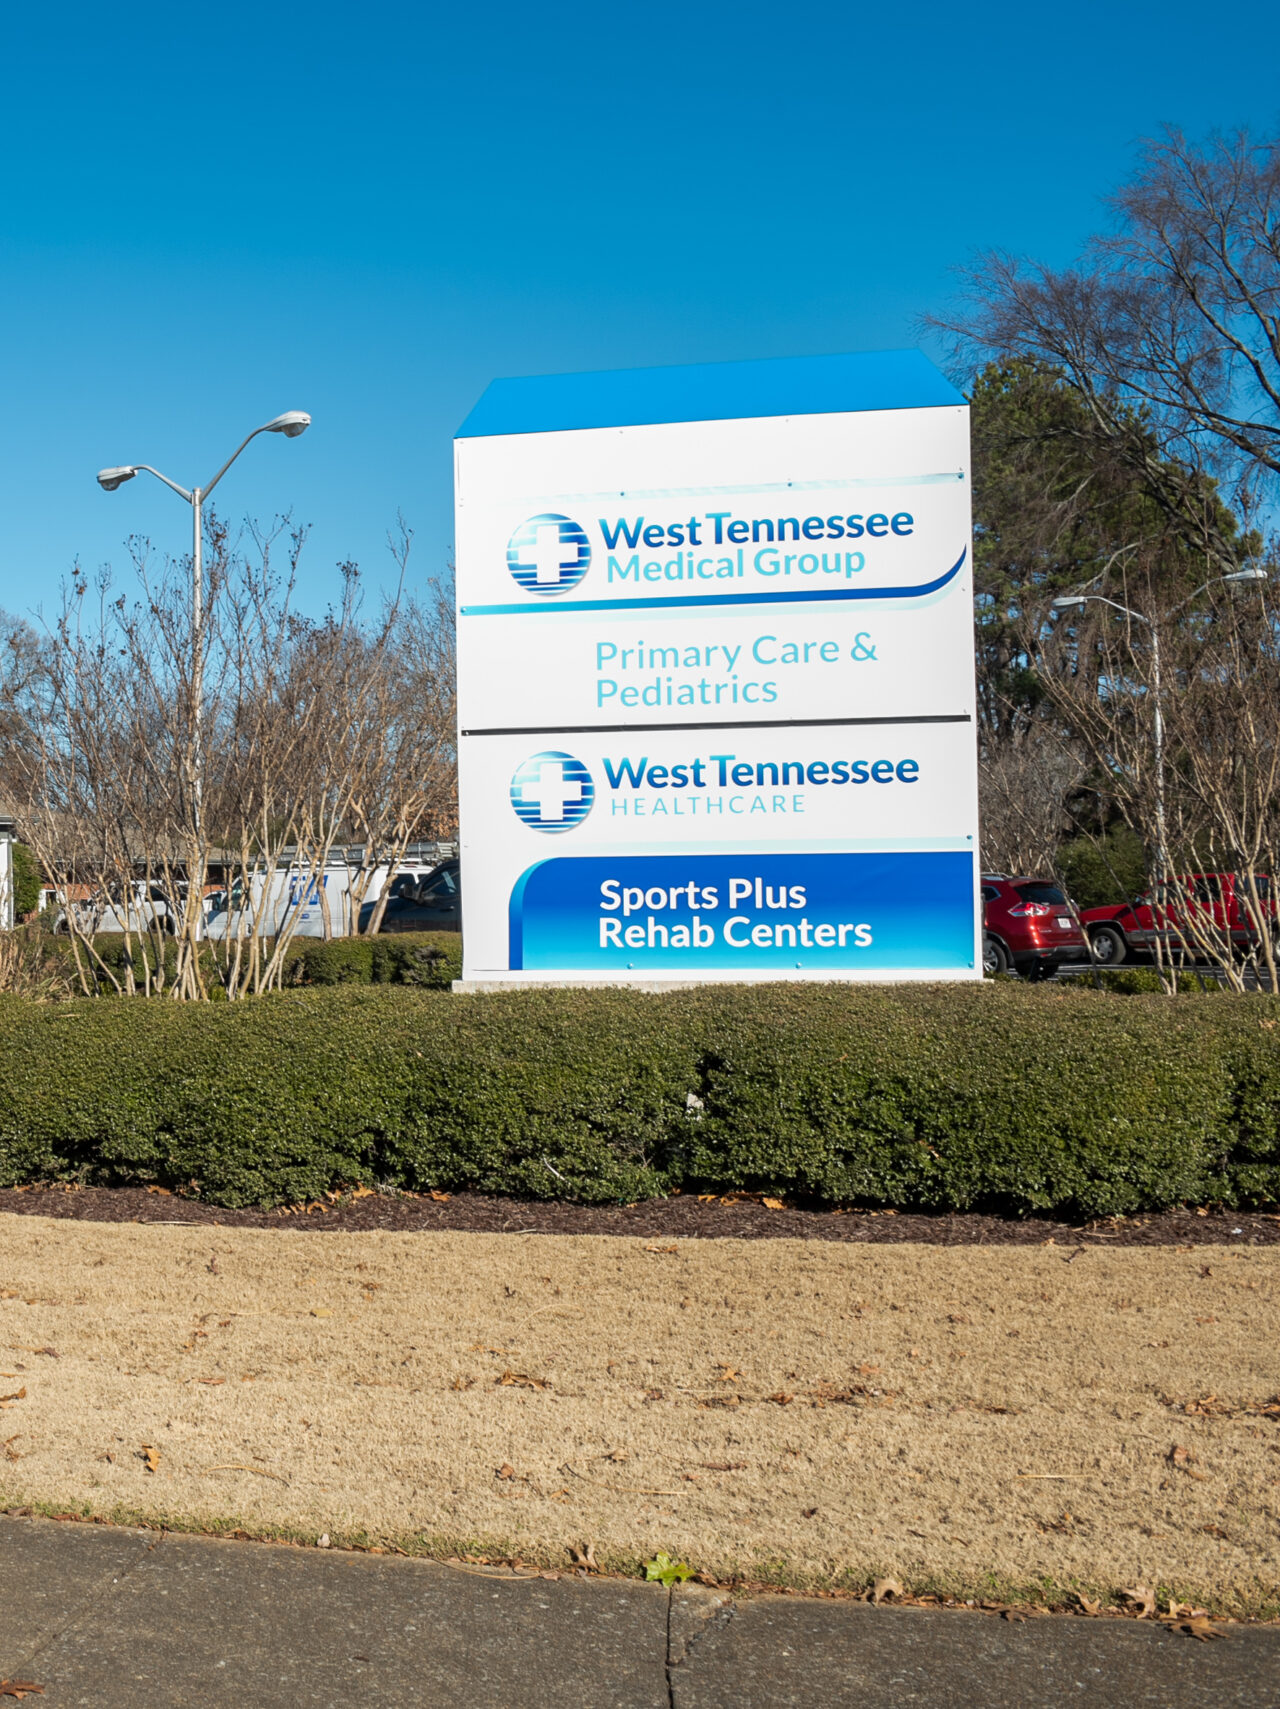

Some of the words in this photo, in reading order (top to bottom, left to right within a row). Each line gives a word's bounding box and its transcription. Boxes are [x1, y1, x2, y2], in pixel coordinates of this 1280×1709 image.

[598, 514, 703, 551] West
[705, 511, 915, 545] Tennessee
[607, 548, 744, 584] Medical
[753, 547, 866, 579] Group
[596, 639, 743, 673] Primary
[752, 635, 841, 665] Care
[850, 631, 879, 662] &
[597, 674, 779, 708] Pediatrics
[602, 756, 707, 790] West
[709, 754, 920, 788] Tennessee
[611, 794, 806, 817] HEALTHCARE
[599, 880, 719, 917] Sports
[729, 877, 807, 910] Plus
[599, 916, 715, 949] Rehab
[723, 915, 873, 948] Centers
